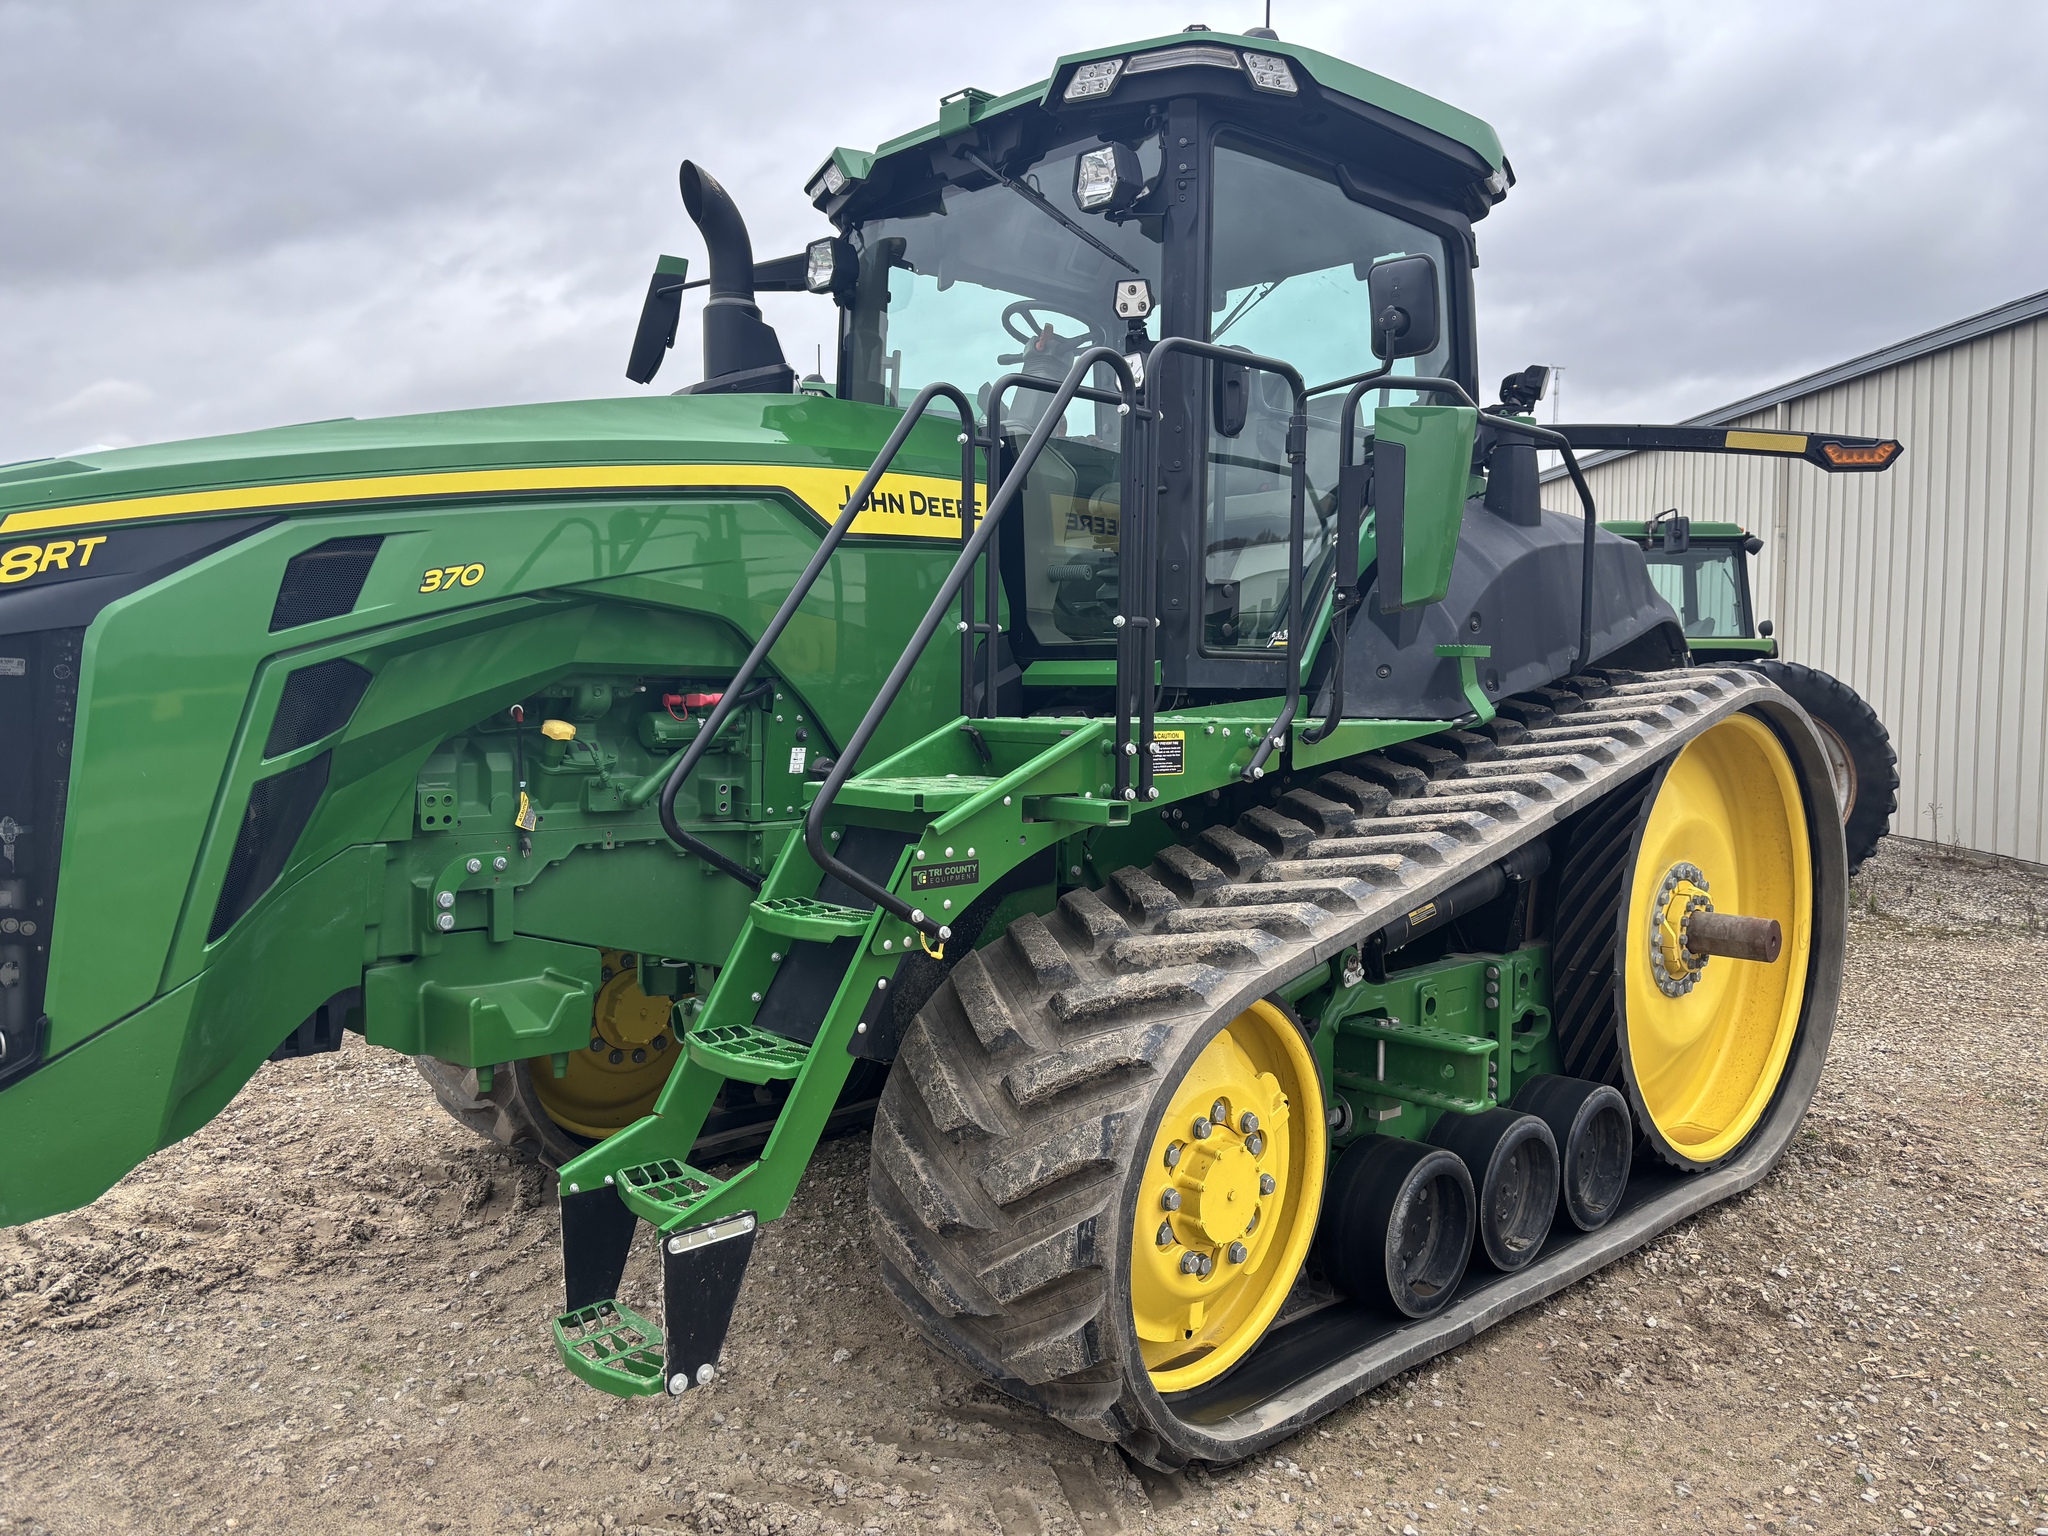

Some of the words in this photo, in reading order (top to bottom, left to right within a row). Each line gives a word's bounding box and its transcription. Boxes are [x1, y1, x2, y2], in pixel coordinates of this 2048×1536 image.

[0, 536, 107, 583] 8RT
[419, 562, 485, 593] 370
[929, 868, 943, 877] TRI
[944, 863, 978, 874] COUNTY
[929, 872, 977, 884] EQUIPMENT
